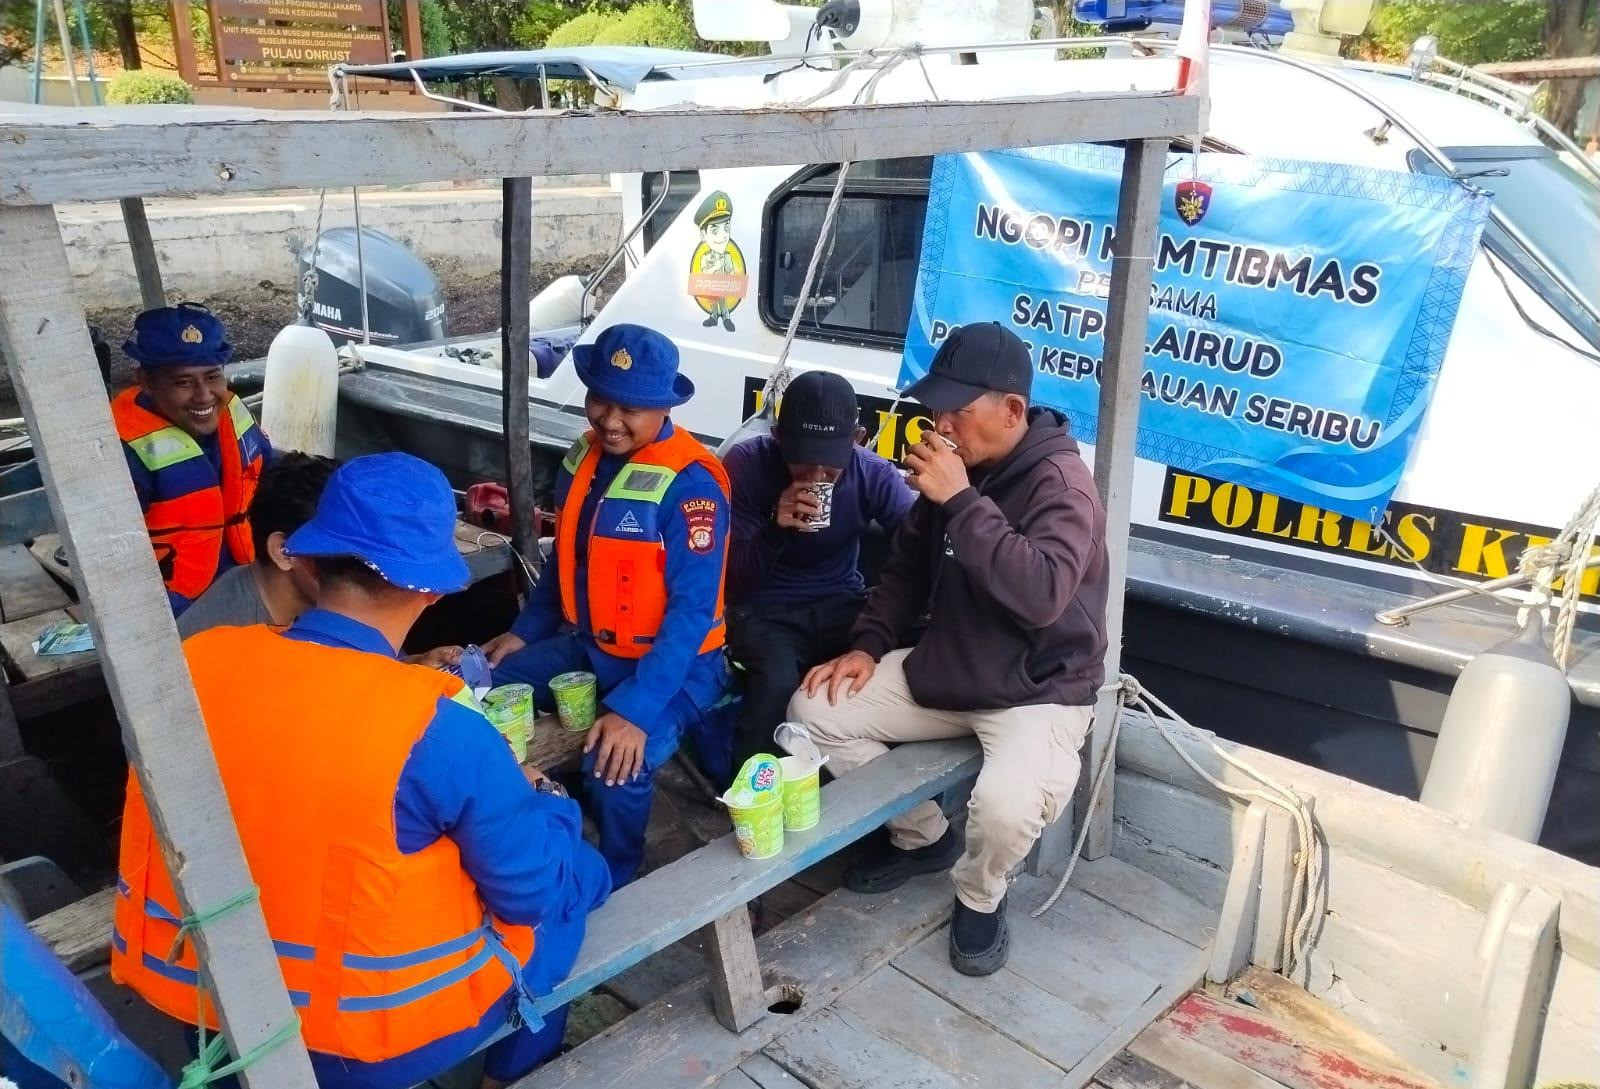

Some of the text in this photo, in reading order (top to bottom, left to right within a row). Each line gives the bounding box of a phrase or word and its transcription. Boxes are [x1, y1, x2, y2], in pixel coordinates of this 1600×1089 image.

[268, 7, 338, 18] DINAS KEBUDAYAAN
[285, 0, 318, 8] PROVINSI
[333, 2, 363, 12] JAKARTA
[240, 27, 281, 36] PENGELOLA
[282, 28, 310, 37] MUSEUM
[311, 31, 353, 40] KEBAHARIAN
[353, 33, 382, 41] JAKARTA
[258, 37, 352, 48] MUSEUM ARKEOLOGI ONRUST
[262, 47, 351, 61] PULAU ONRUST
[975, 203, 1382, 306] NGOPI KMTIBMAS
[424, 303, 445, 321] 200
[1012, 293, 1282, 379] SATPAIRUD
[1038, 345, 1239, 417] KEPAUAN
[1244, 397, 1383, 450] SERIBU
[802, 423, 835, 431] OUTLAW
[1165, 472, 1437, 563] POLRES
